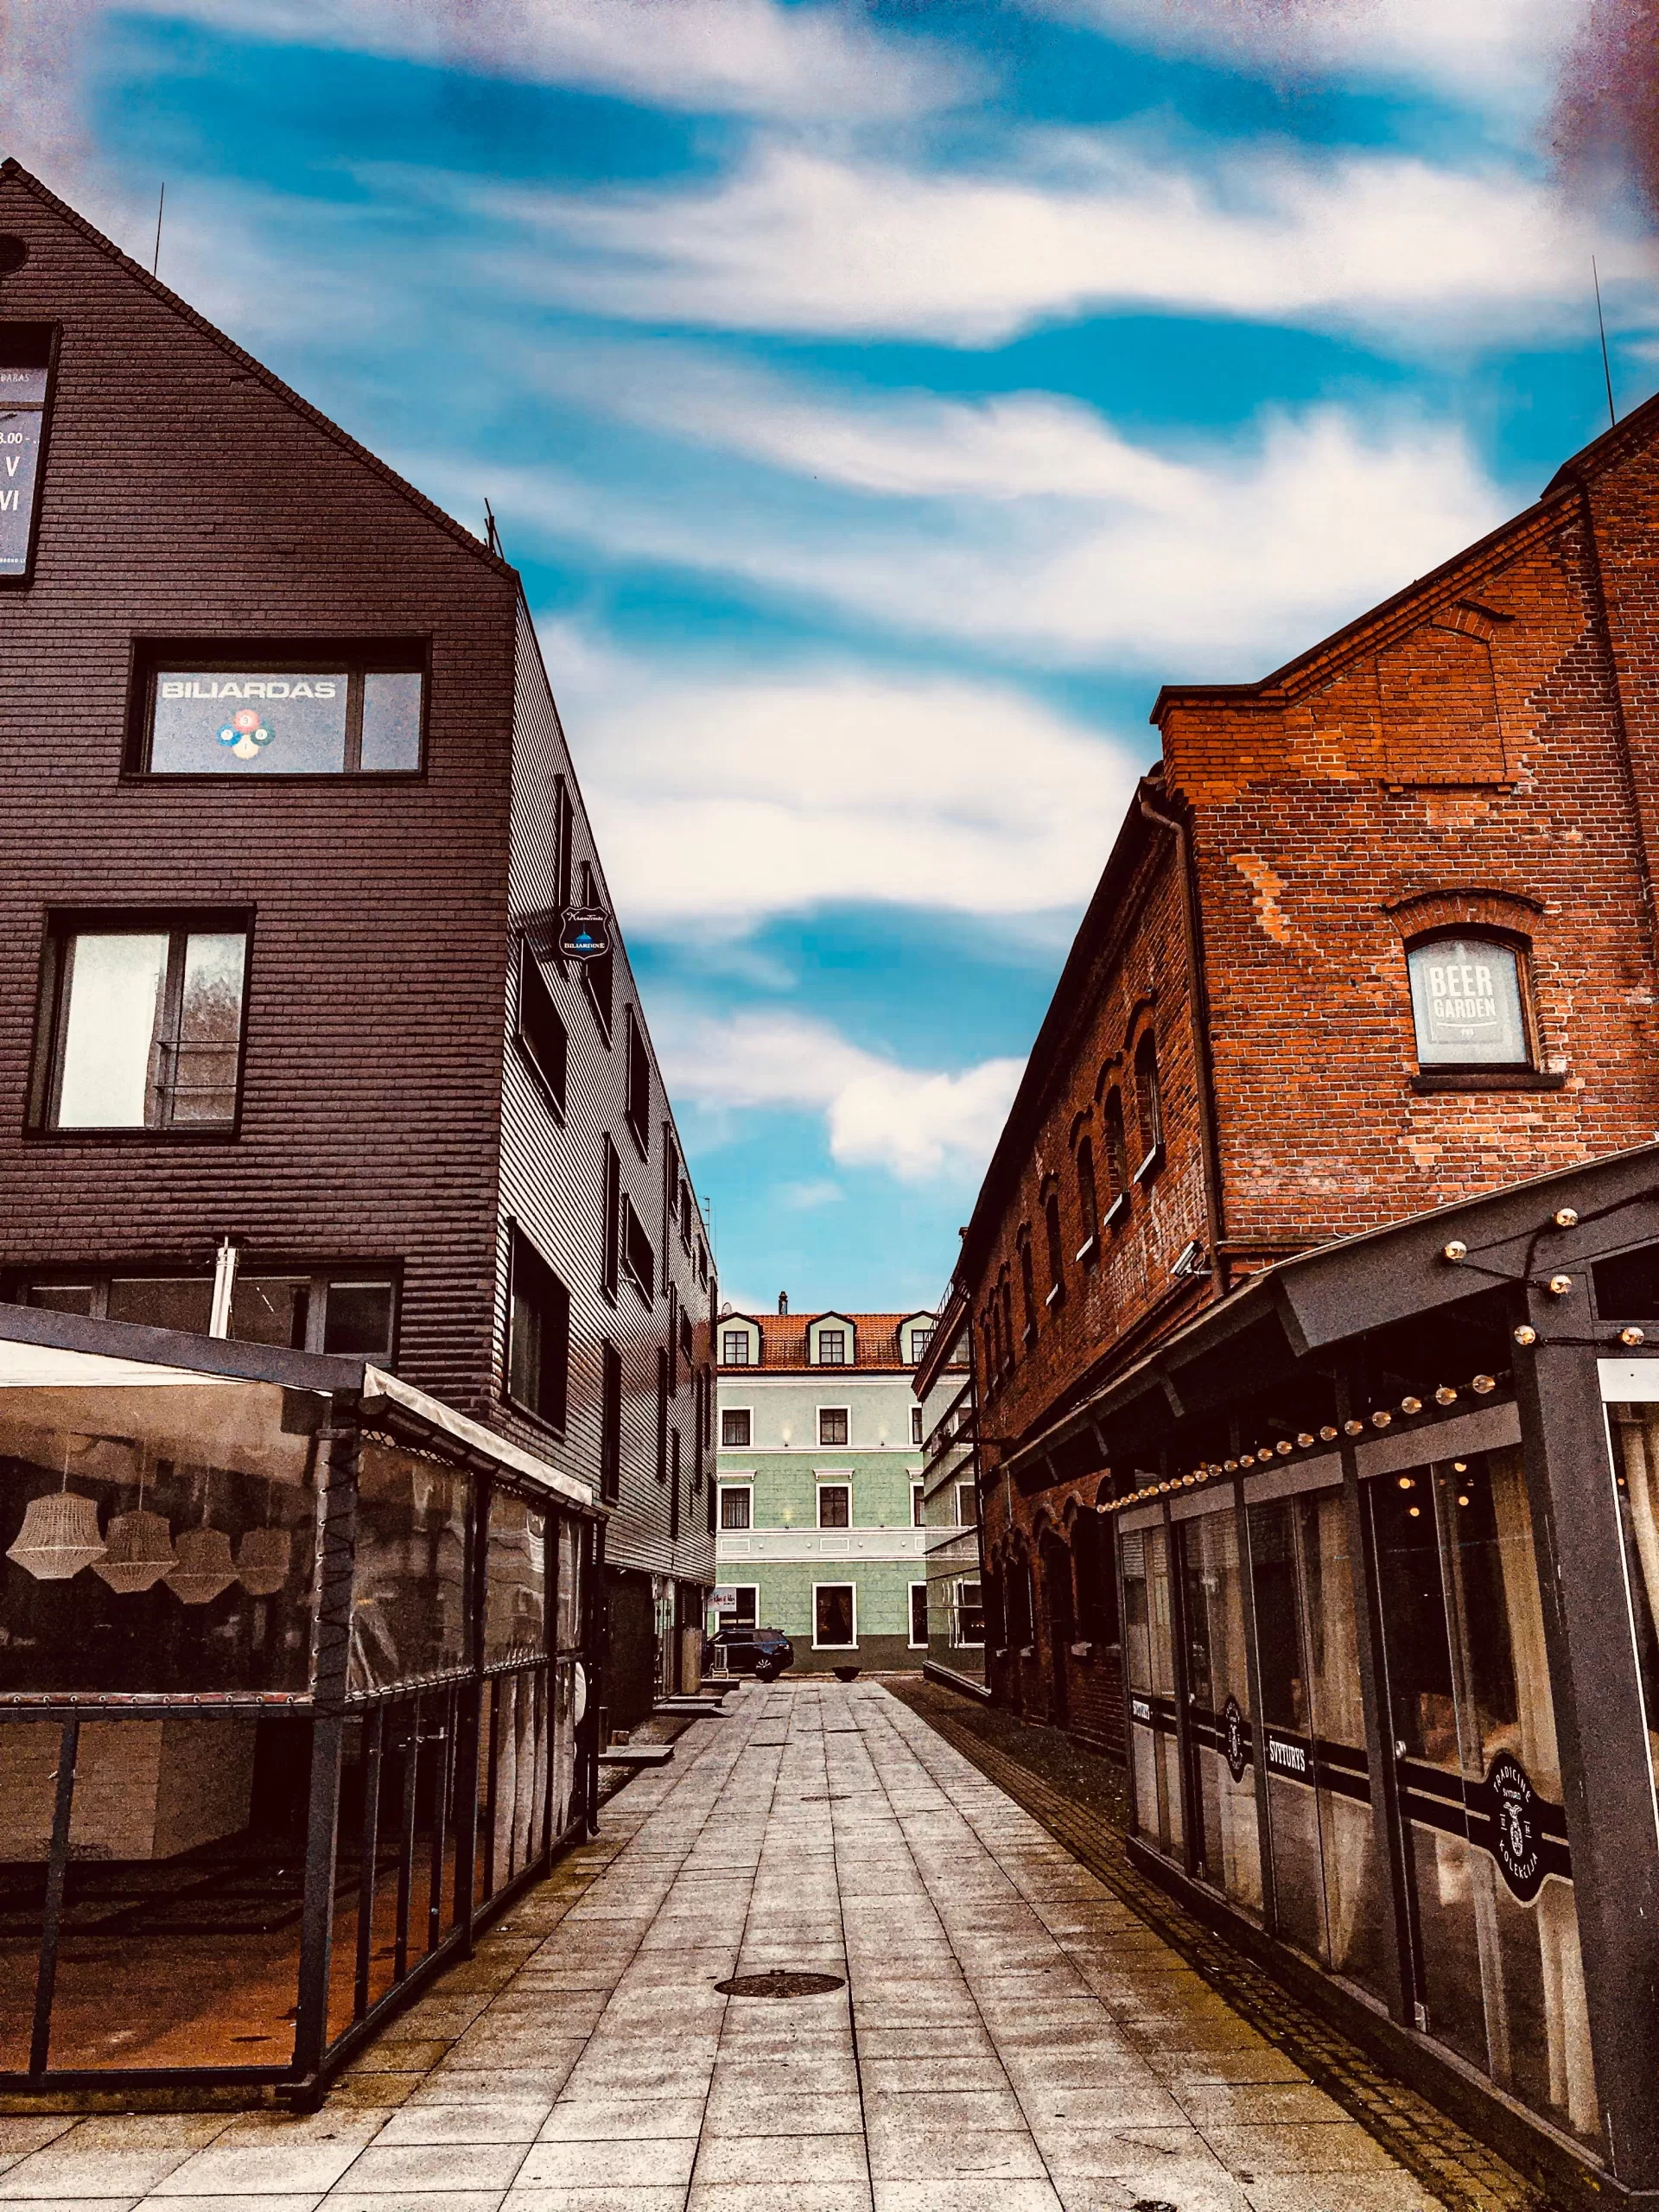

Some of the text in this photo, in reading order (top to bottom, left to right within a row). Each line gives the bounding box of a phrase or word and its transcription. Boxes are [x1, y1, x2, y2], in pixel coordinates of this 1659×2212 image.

[162, 681, 336, 699] BILIARDAS
[1429, 965, 1493, 996] BEER
[1433, 997, 1497, 1018] GARDEN
